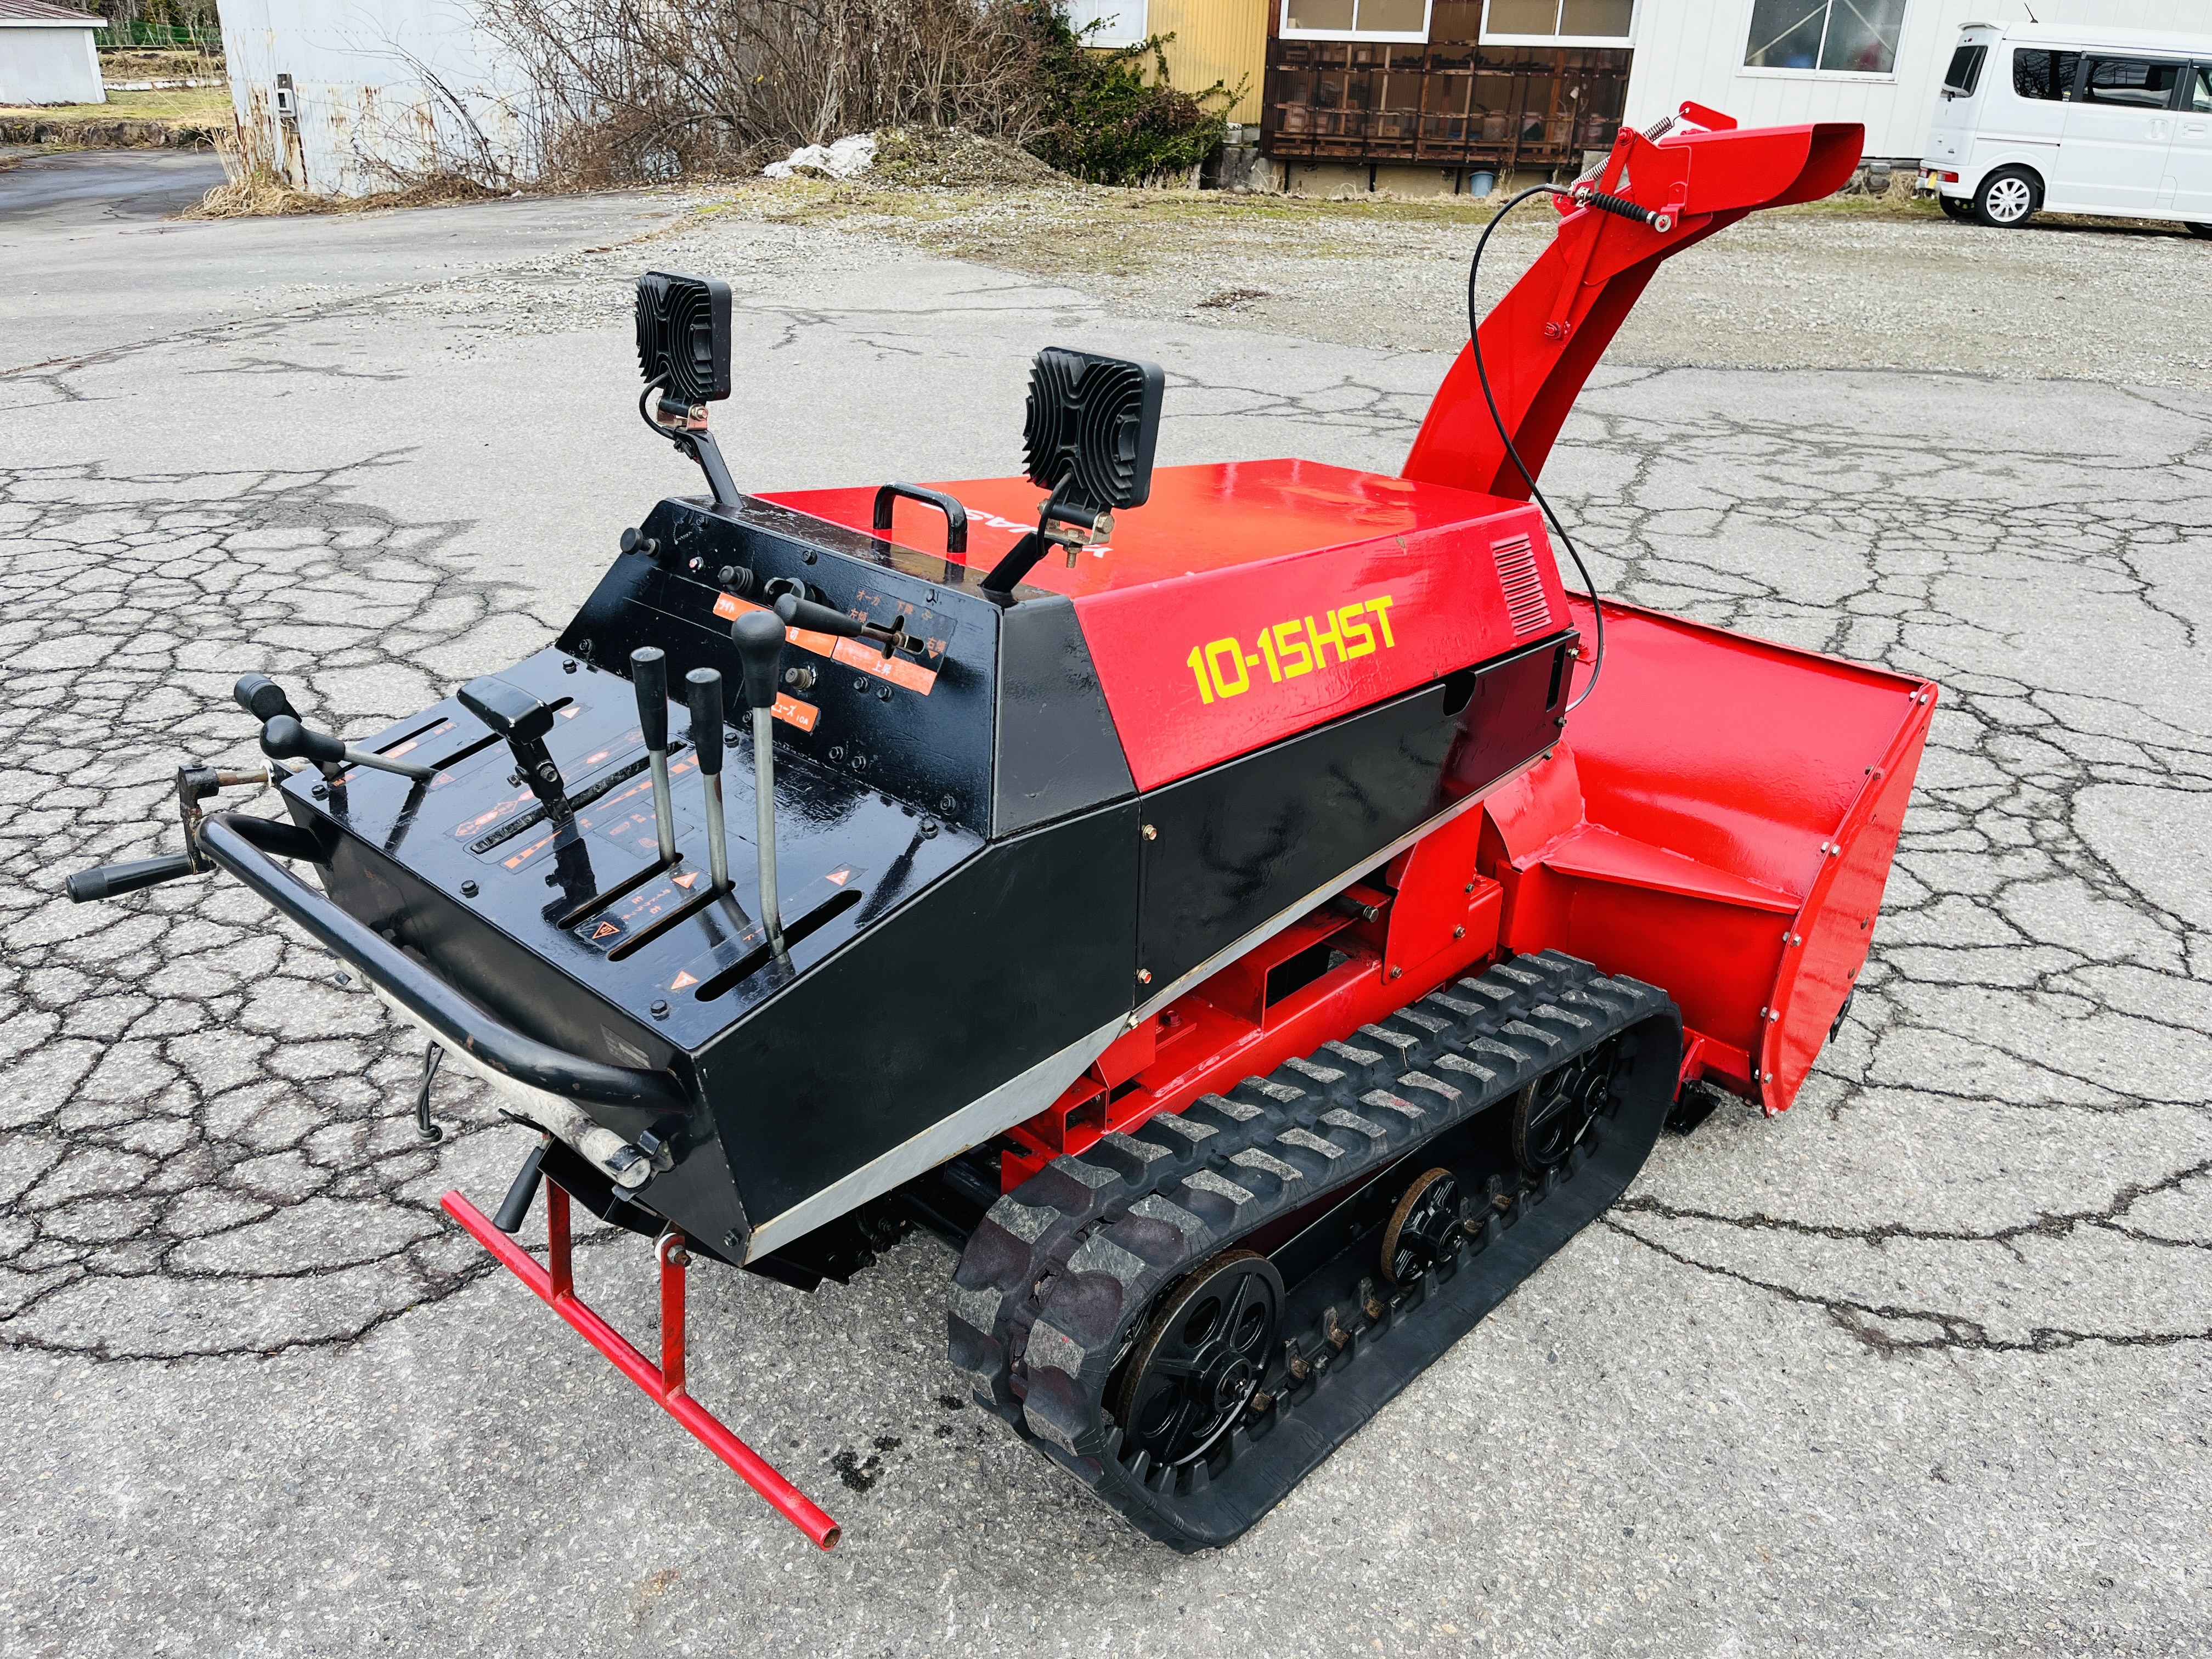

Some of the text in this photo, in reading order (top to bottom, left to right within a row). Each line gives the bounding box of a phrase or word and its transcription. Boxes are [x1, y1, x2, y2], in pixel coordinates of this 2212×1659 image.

[918, 501, 1113, 558] YNAS
[872, 661, 892, 676] 上昇
[1187, 595, 1395, 704] 10-15HST
